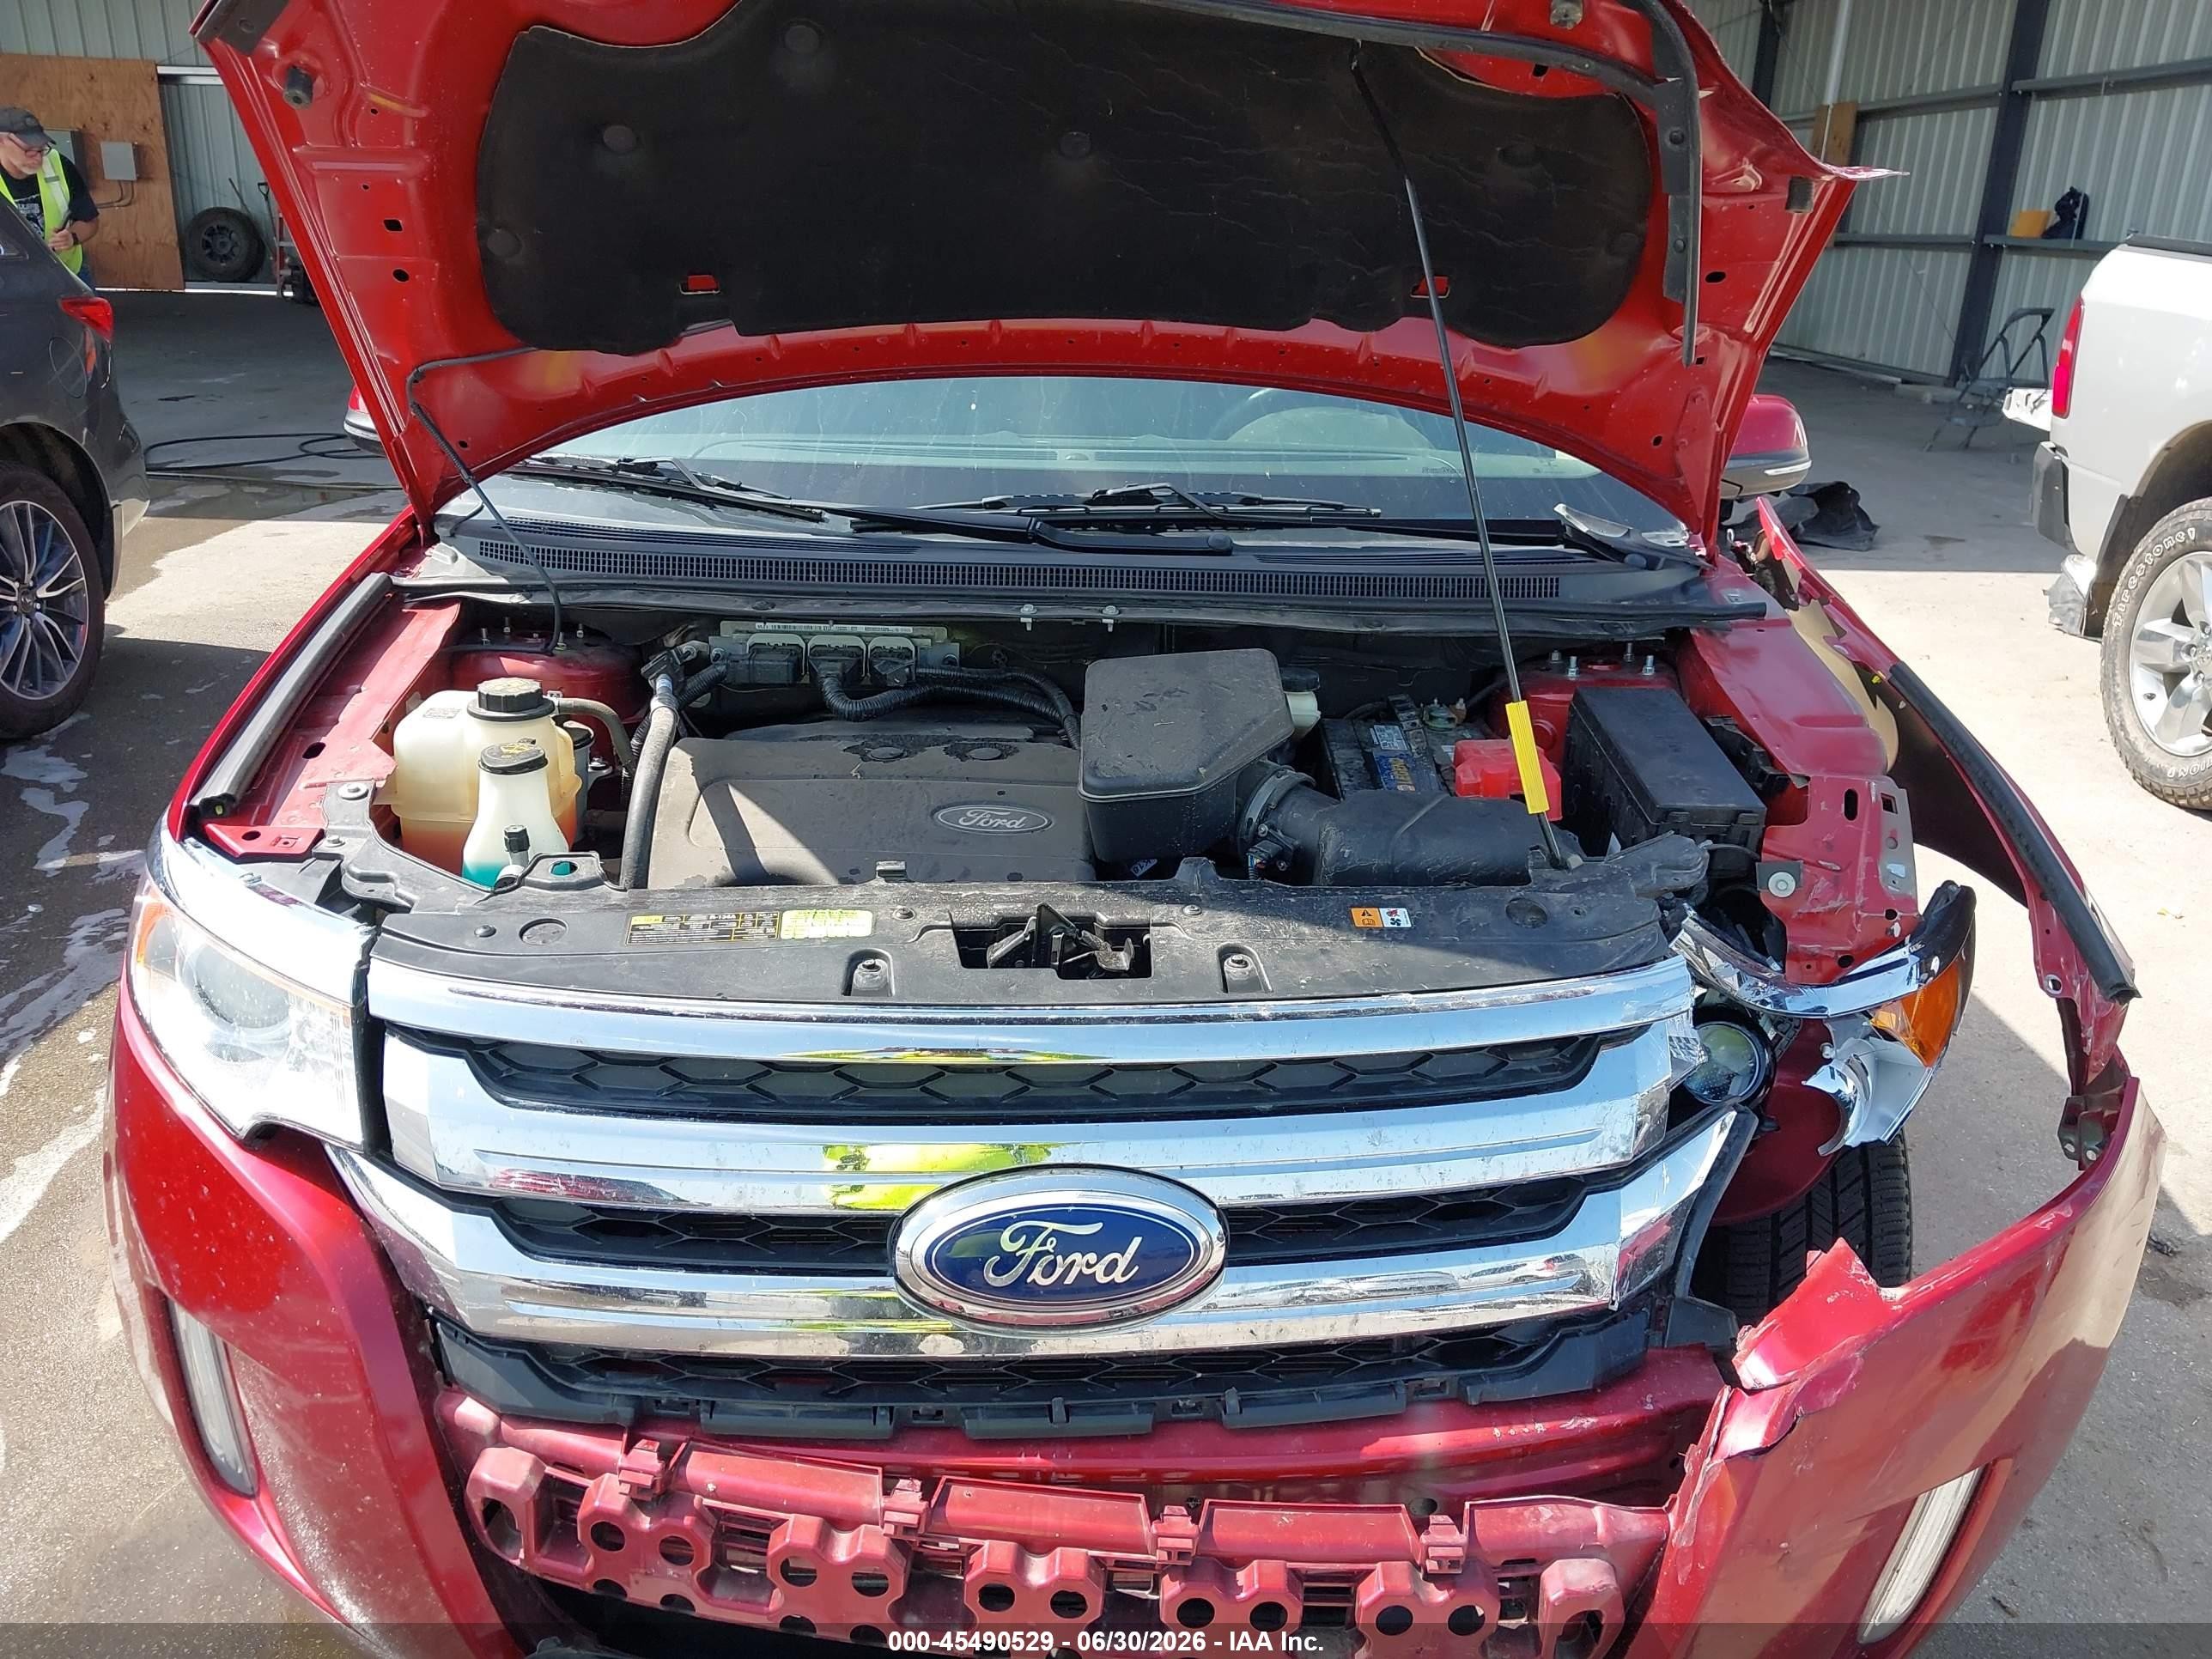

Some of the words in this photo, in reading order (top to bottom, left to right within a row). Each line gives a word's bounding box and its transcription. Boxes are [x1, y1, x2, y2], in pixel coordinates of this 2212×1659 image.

[2112, 531, 2185, 627] Firestone
[958, 809, 1028, 829] Ford
[983, 1220, 1143, 1286] Ford
